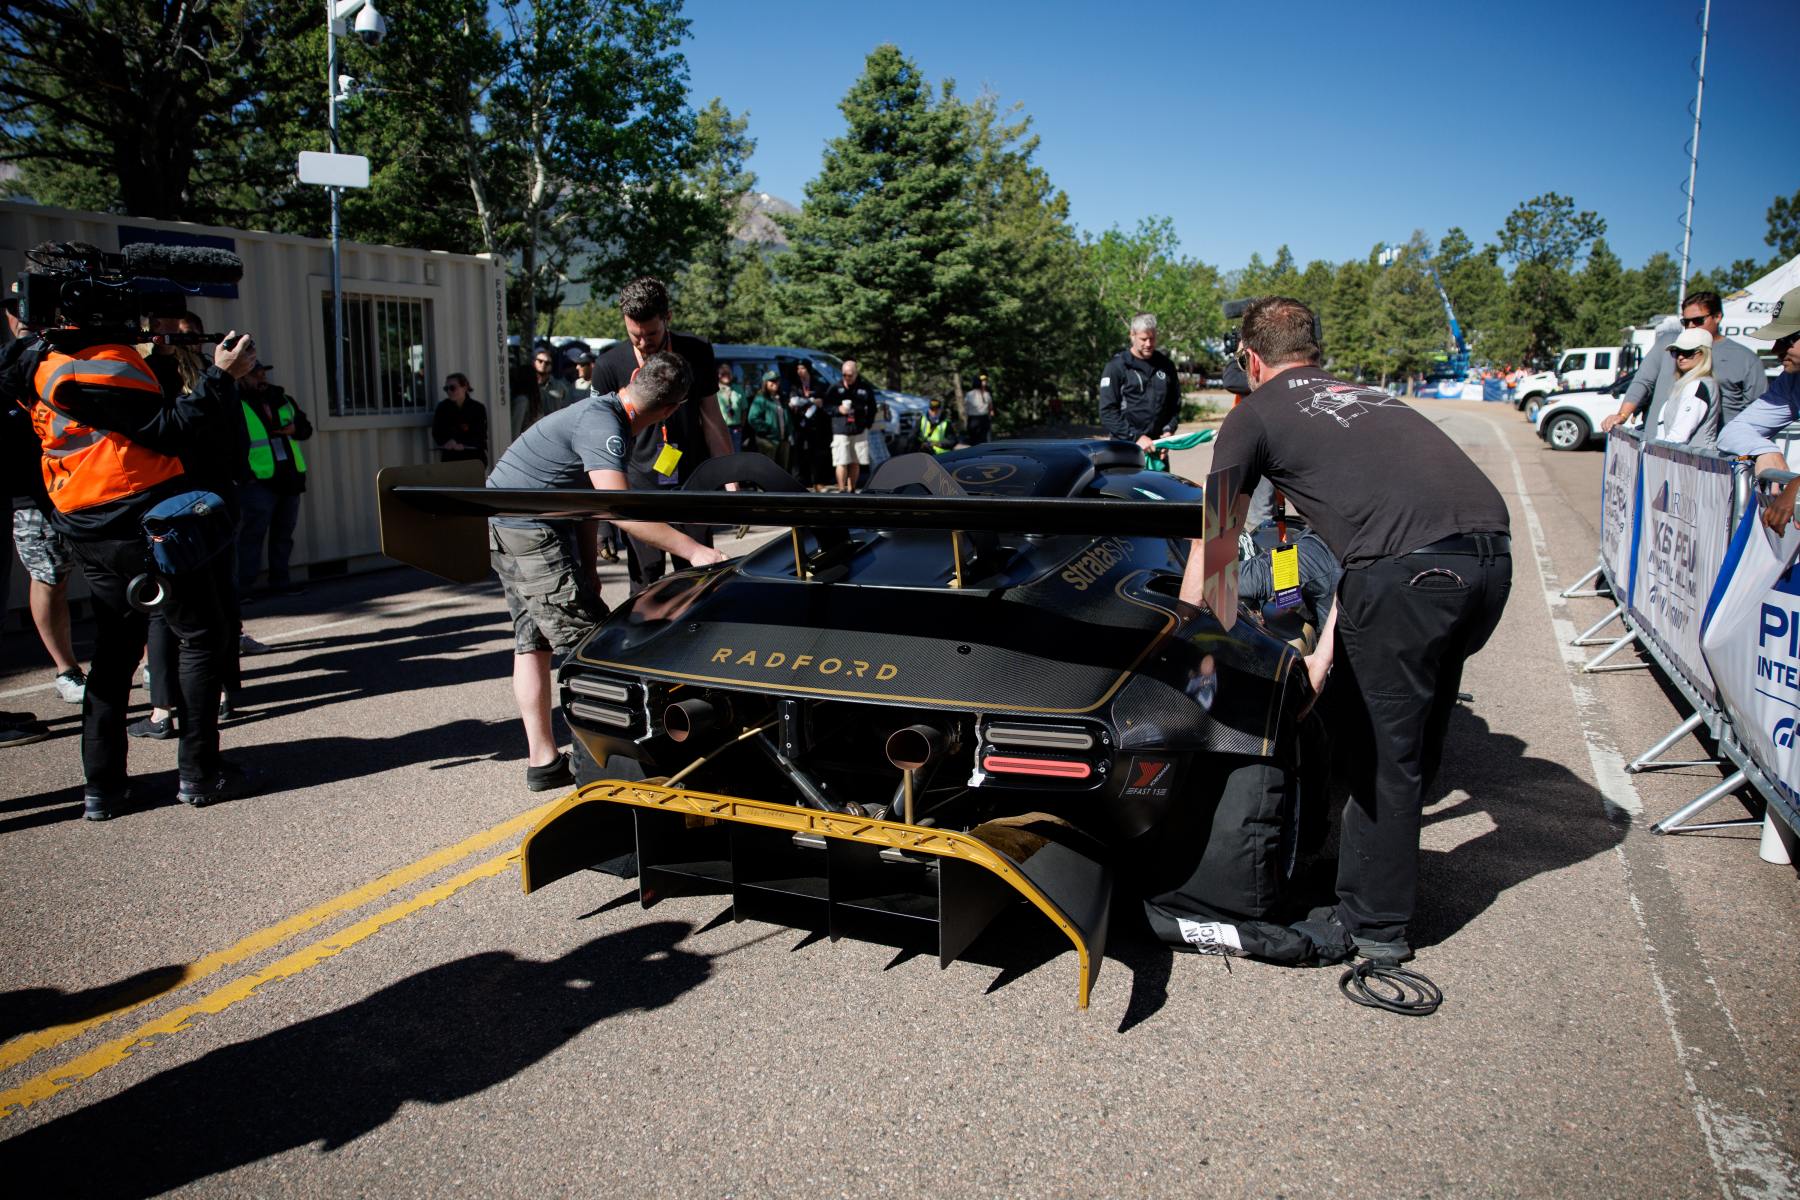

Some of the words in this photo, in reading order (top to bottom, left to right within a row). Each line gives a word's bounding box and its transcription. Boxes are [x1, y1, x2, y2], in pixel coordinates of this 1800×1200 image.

[1061, 536, 1134, 591] stratasys
[1759, 602, 1800, 660] PI
[711, 647, 898, 681] RADFORD
[1757, 655, 1800, 691] INTE
